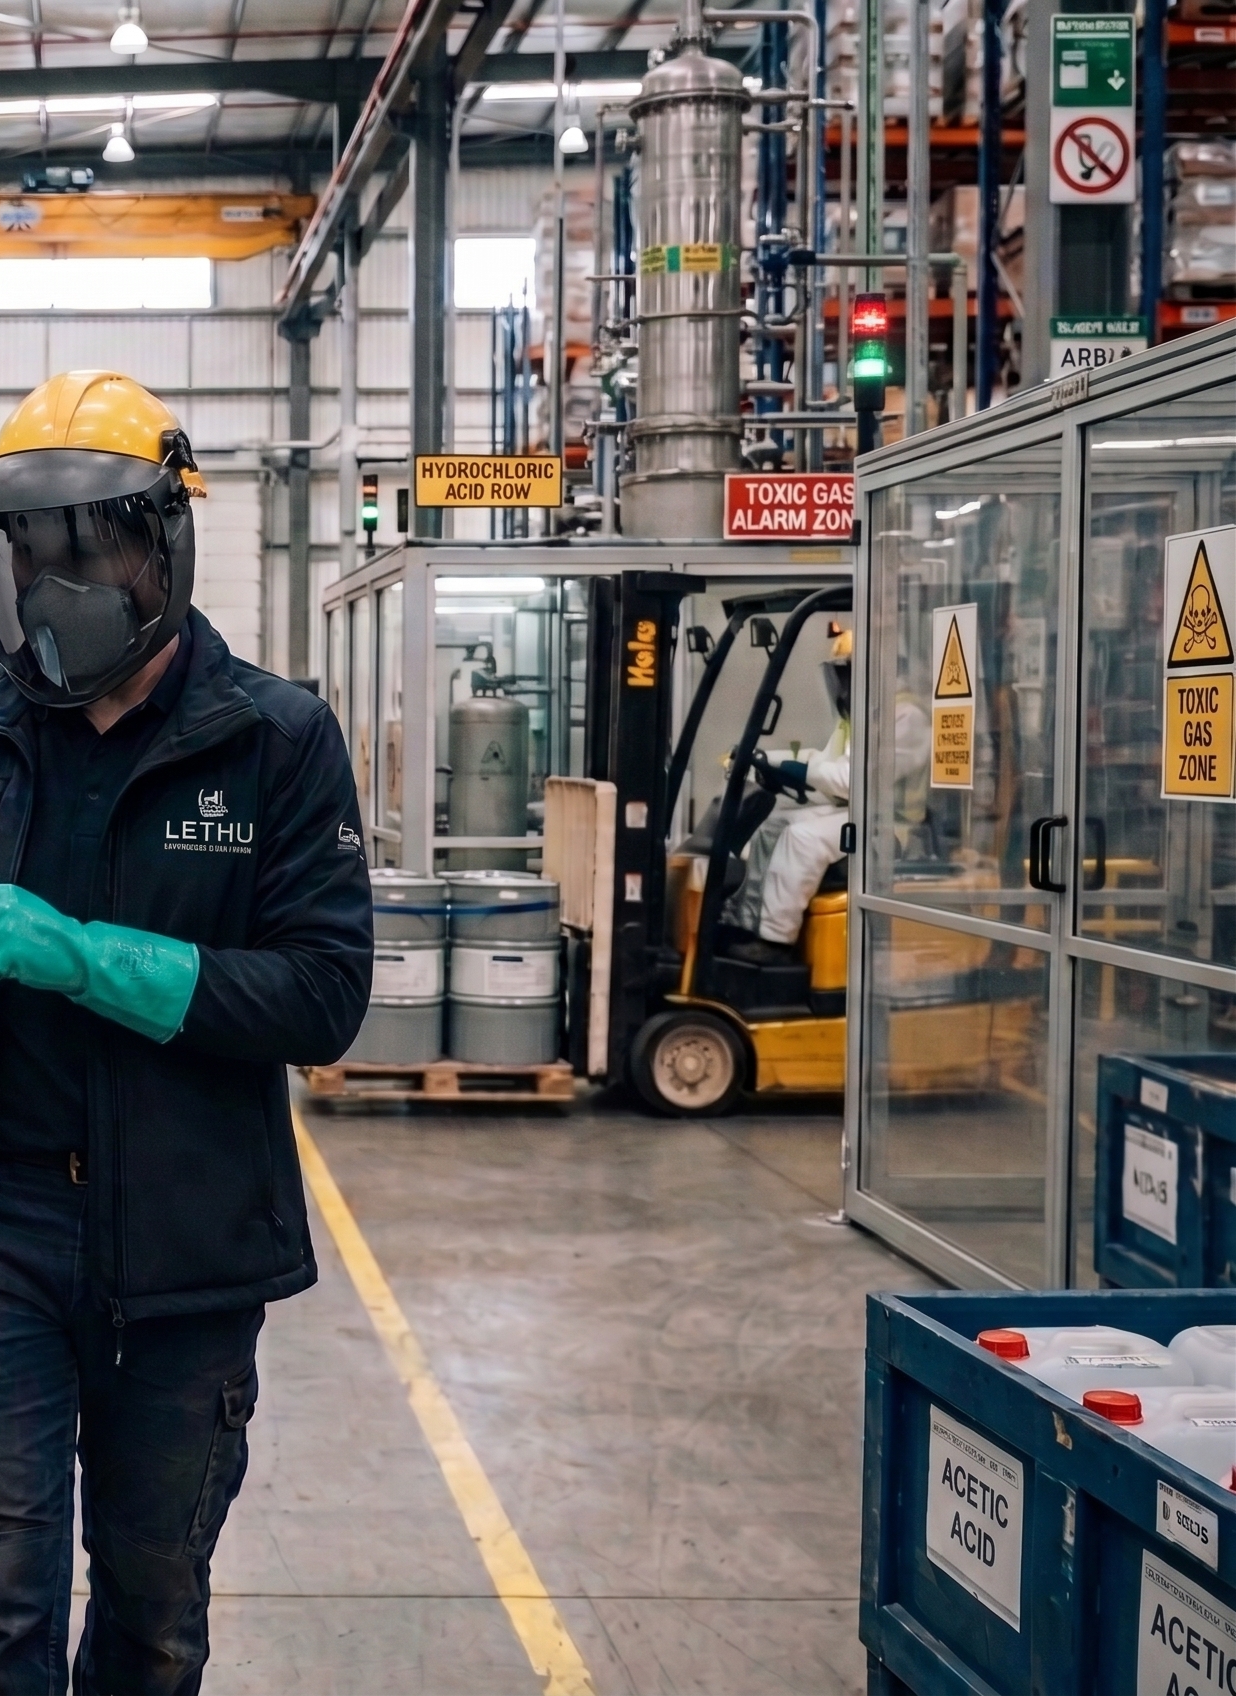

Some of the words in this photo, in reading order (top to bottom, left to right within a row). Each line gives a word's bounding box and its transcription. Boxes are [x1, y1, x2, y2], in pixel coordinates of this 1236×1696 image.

[421, 461, 554, 479] HYDROCHLORIC
[444, 482, 485, 500] ACID
[490, 482, 532, 500] ROW
[745, 482, 807, 505] TOXIC
[812, 482, 854, 505] GAS
[731, 508, 807, 530] ALARM
[812, 508, 854, 530] ZON
[1177, 686, 1219, 715] TOXIC
[1183, 720, 1213, 747] GAS
[1178, 754, 1217, 781] ZONE
[165, 820, 254, 843] LETHU
[941, 1457, 1009, 1529] ACETIC
[950, 1510, 996, 1568] ACID
